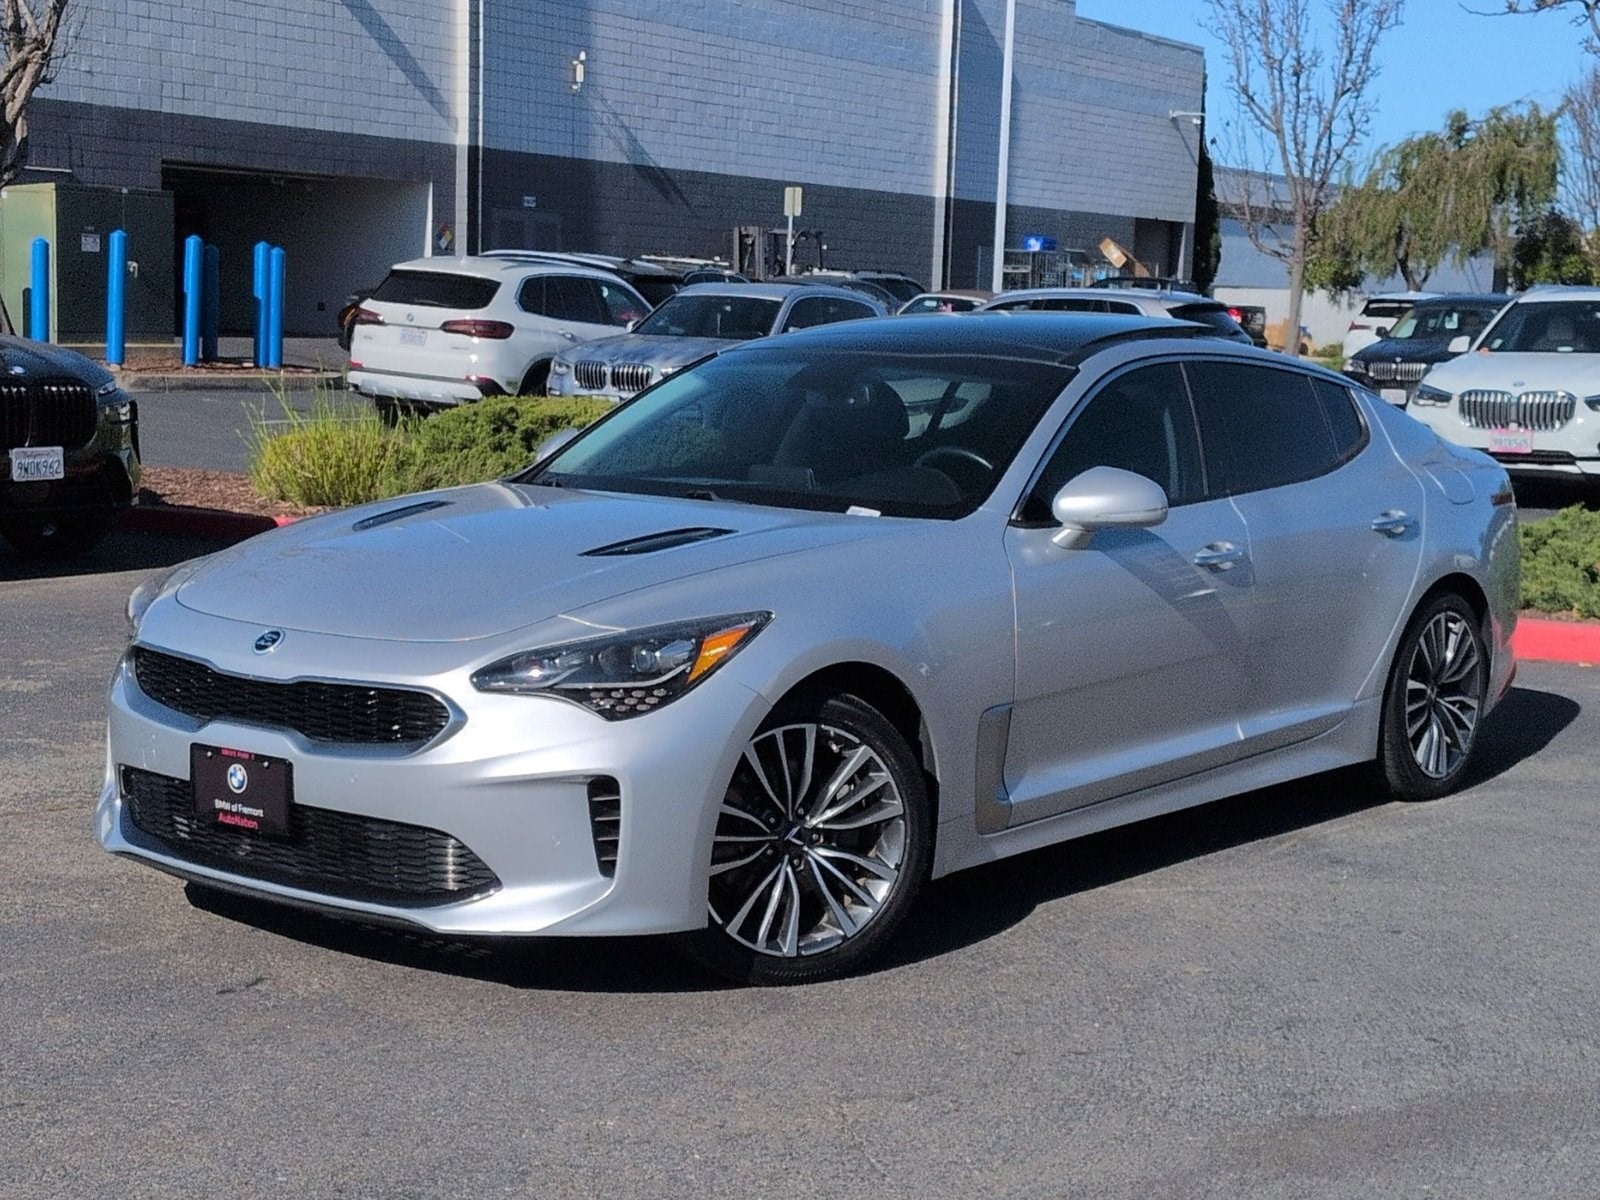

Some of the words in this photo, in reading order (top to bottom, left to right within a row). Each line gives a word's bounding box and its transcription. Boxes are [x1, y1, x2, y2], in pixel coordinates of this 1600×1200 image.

[214, 798, 231, 811] BMW
[238, 803, 264, 818] Fremont
[218, 812, 258, 830] AutoNation
